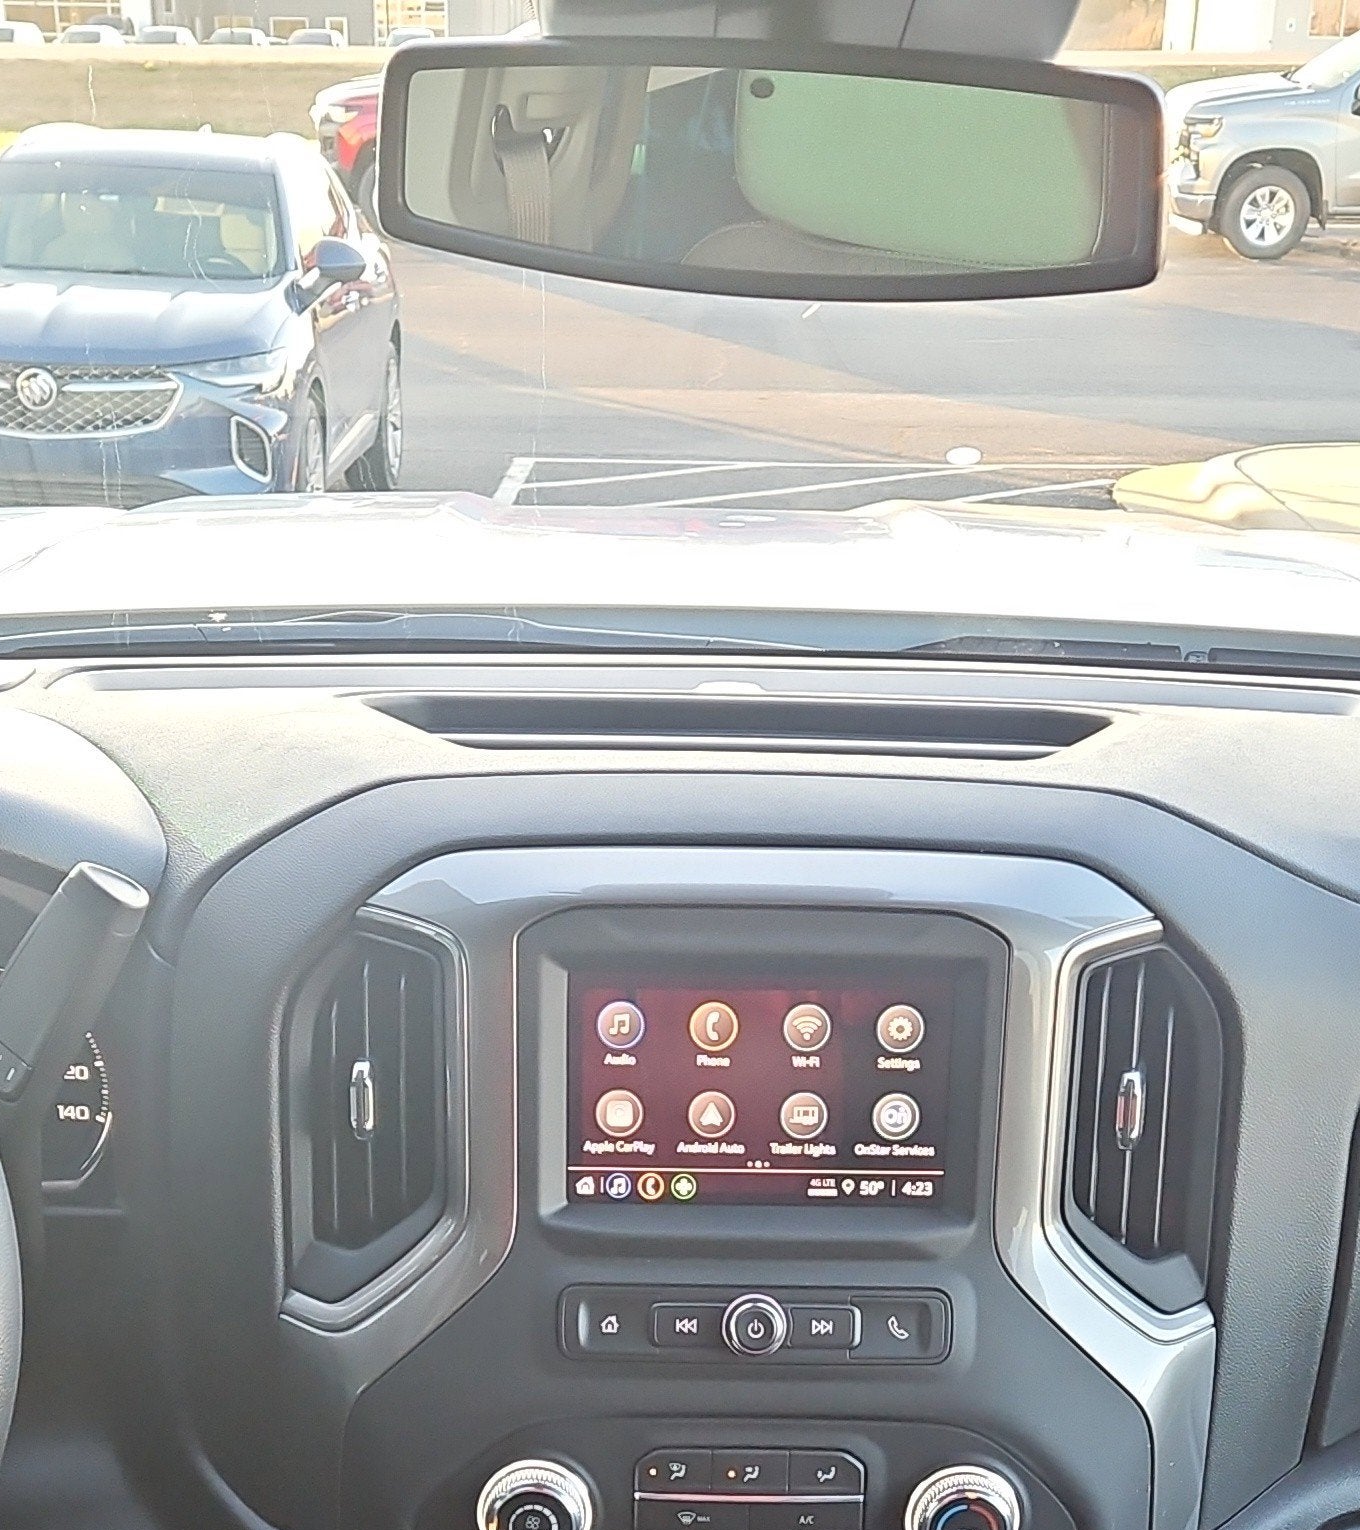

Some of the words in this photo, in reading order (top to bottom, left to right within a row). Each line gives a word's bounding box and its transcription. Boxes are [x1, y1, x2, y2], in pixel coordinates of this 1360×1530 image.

[604, 1053, 637, 1066] Audio
[696, 1054, 730, 1066] Phone
[792, 1056, 820, 1068] Wi-Fi
[877, 1057, 920, 1072] Settings
[63, 1065, 89, 1080] 20
[56, 1104, 90, 1120] 140
[582, 1140, 614, 1154] Apple
[616, 1142, 656, 1155] CarPlay
[676, 1142, 718, 1154] Android
[719, 1142, 746, 1154] Auto
[770, 1142, 803, 1154] Trailer
[804, 1142, 836, 1157] Lights
[854, 1144, 892, 1156] OnStar
[892, 1144, 936, 1156] Services
[810, 1178, 822, 1187] 4G
[822, 1178, 836, 1187] LTE
[901, 1181, 933, 1196] 4:23
[798, 1516, 814, 1524] A/C
